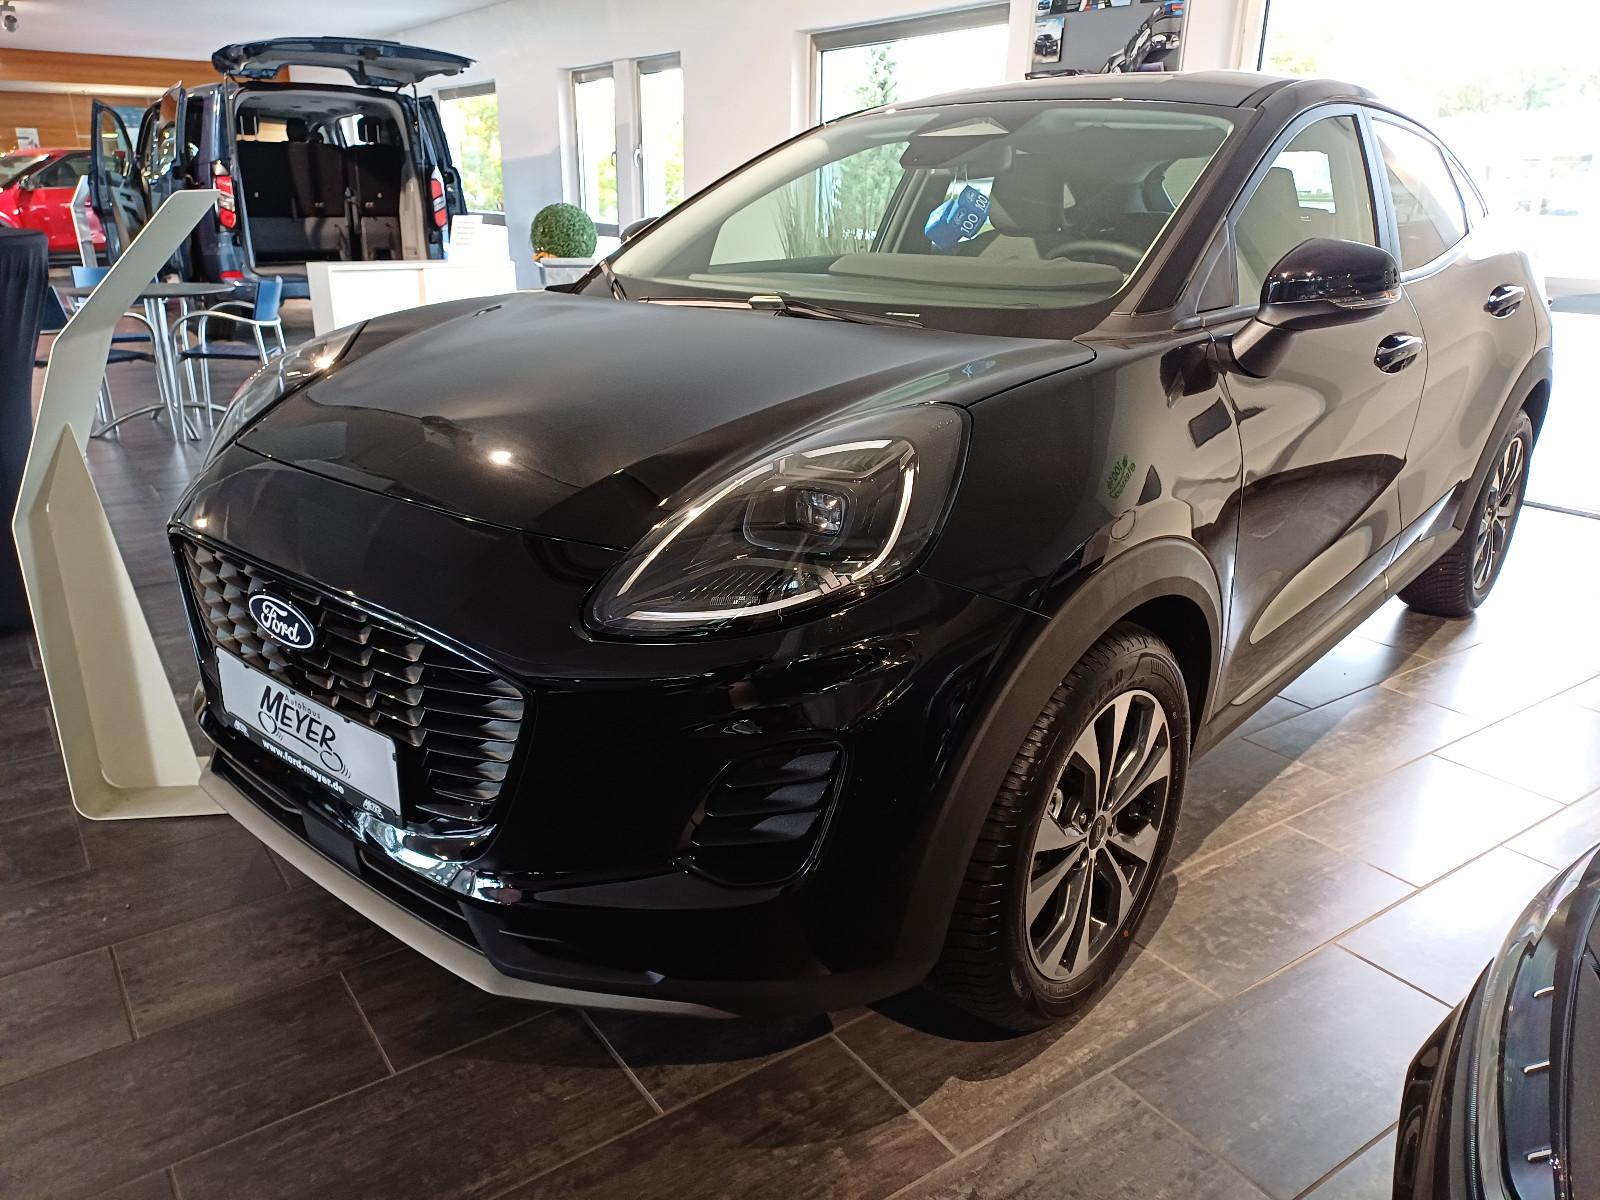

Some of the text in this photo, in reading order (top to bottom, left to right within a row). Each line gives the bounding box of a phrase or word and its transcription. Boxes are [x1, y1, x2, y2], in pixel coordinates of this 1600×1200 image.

[960, 213, 979, 233] 100
[260, 601, 300, 643] Ford
[259, 685, 336, 752] MEYER
[284, 694, 321, 719] Autohaus
[262, 740, 345, 795] www.ford-meyer.de
